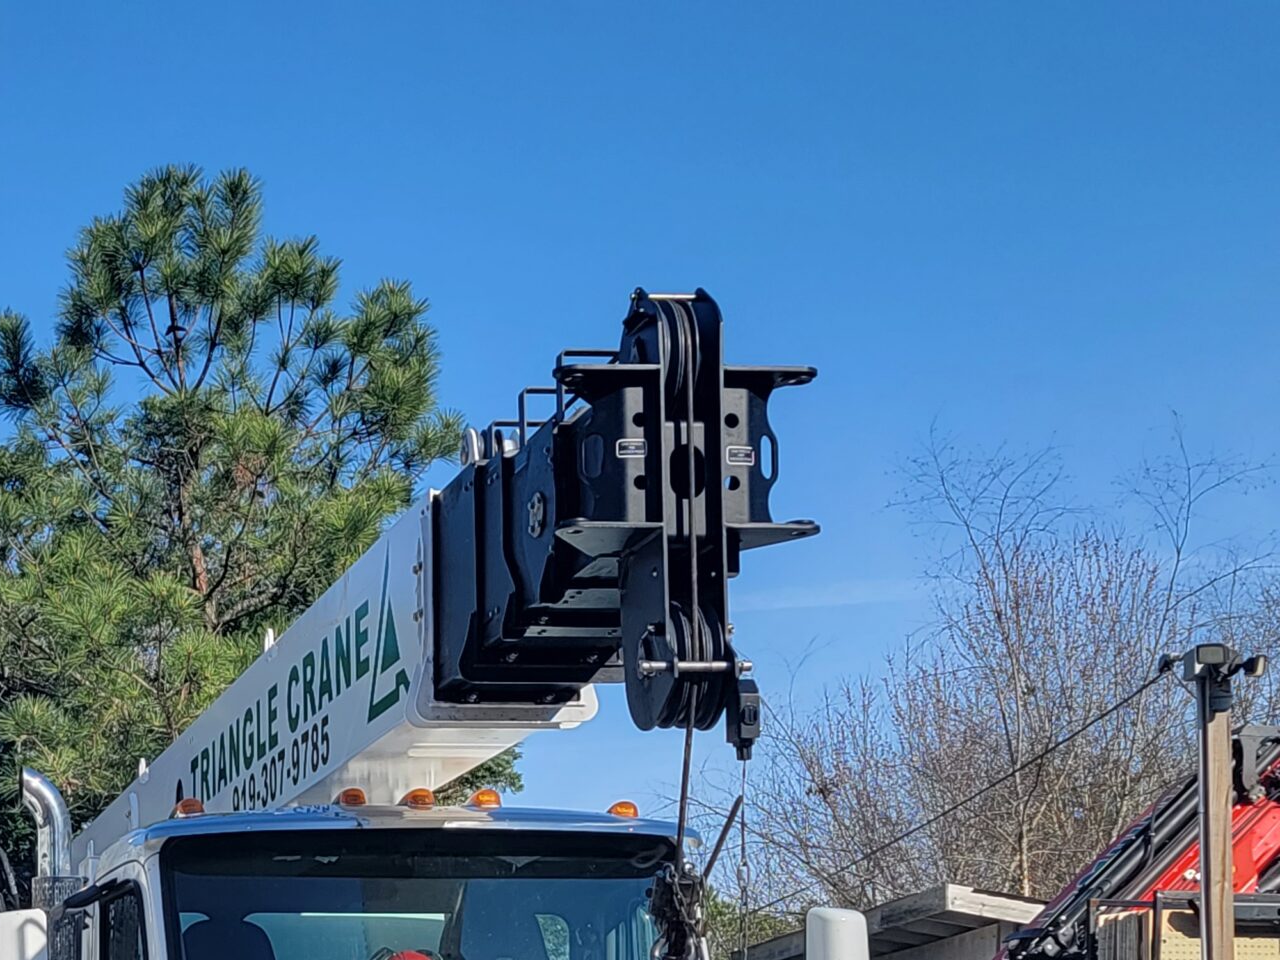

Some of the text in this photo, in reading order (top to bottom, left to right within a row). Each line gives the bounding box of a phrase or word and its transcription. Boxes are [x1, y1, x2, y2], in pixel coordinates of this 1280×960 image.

[190, 600, 370, 805] TRIANGLE CRANE
[232, 715, 330, 811] 919-307-9785
